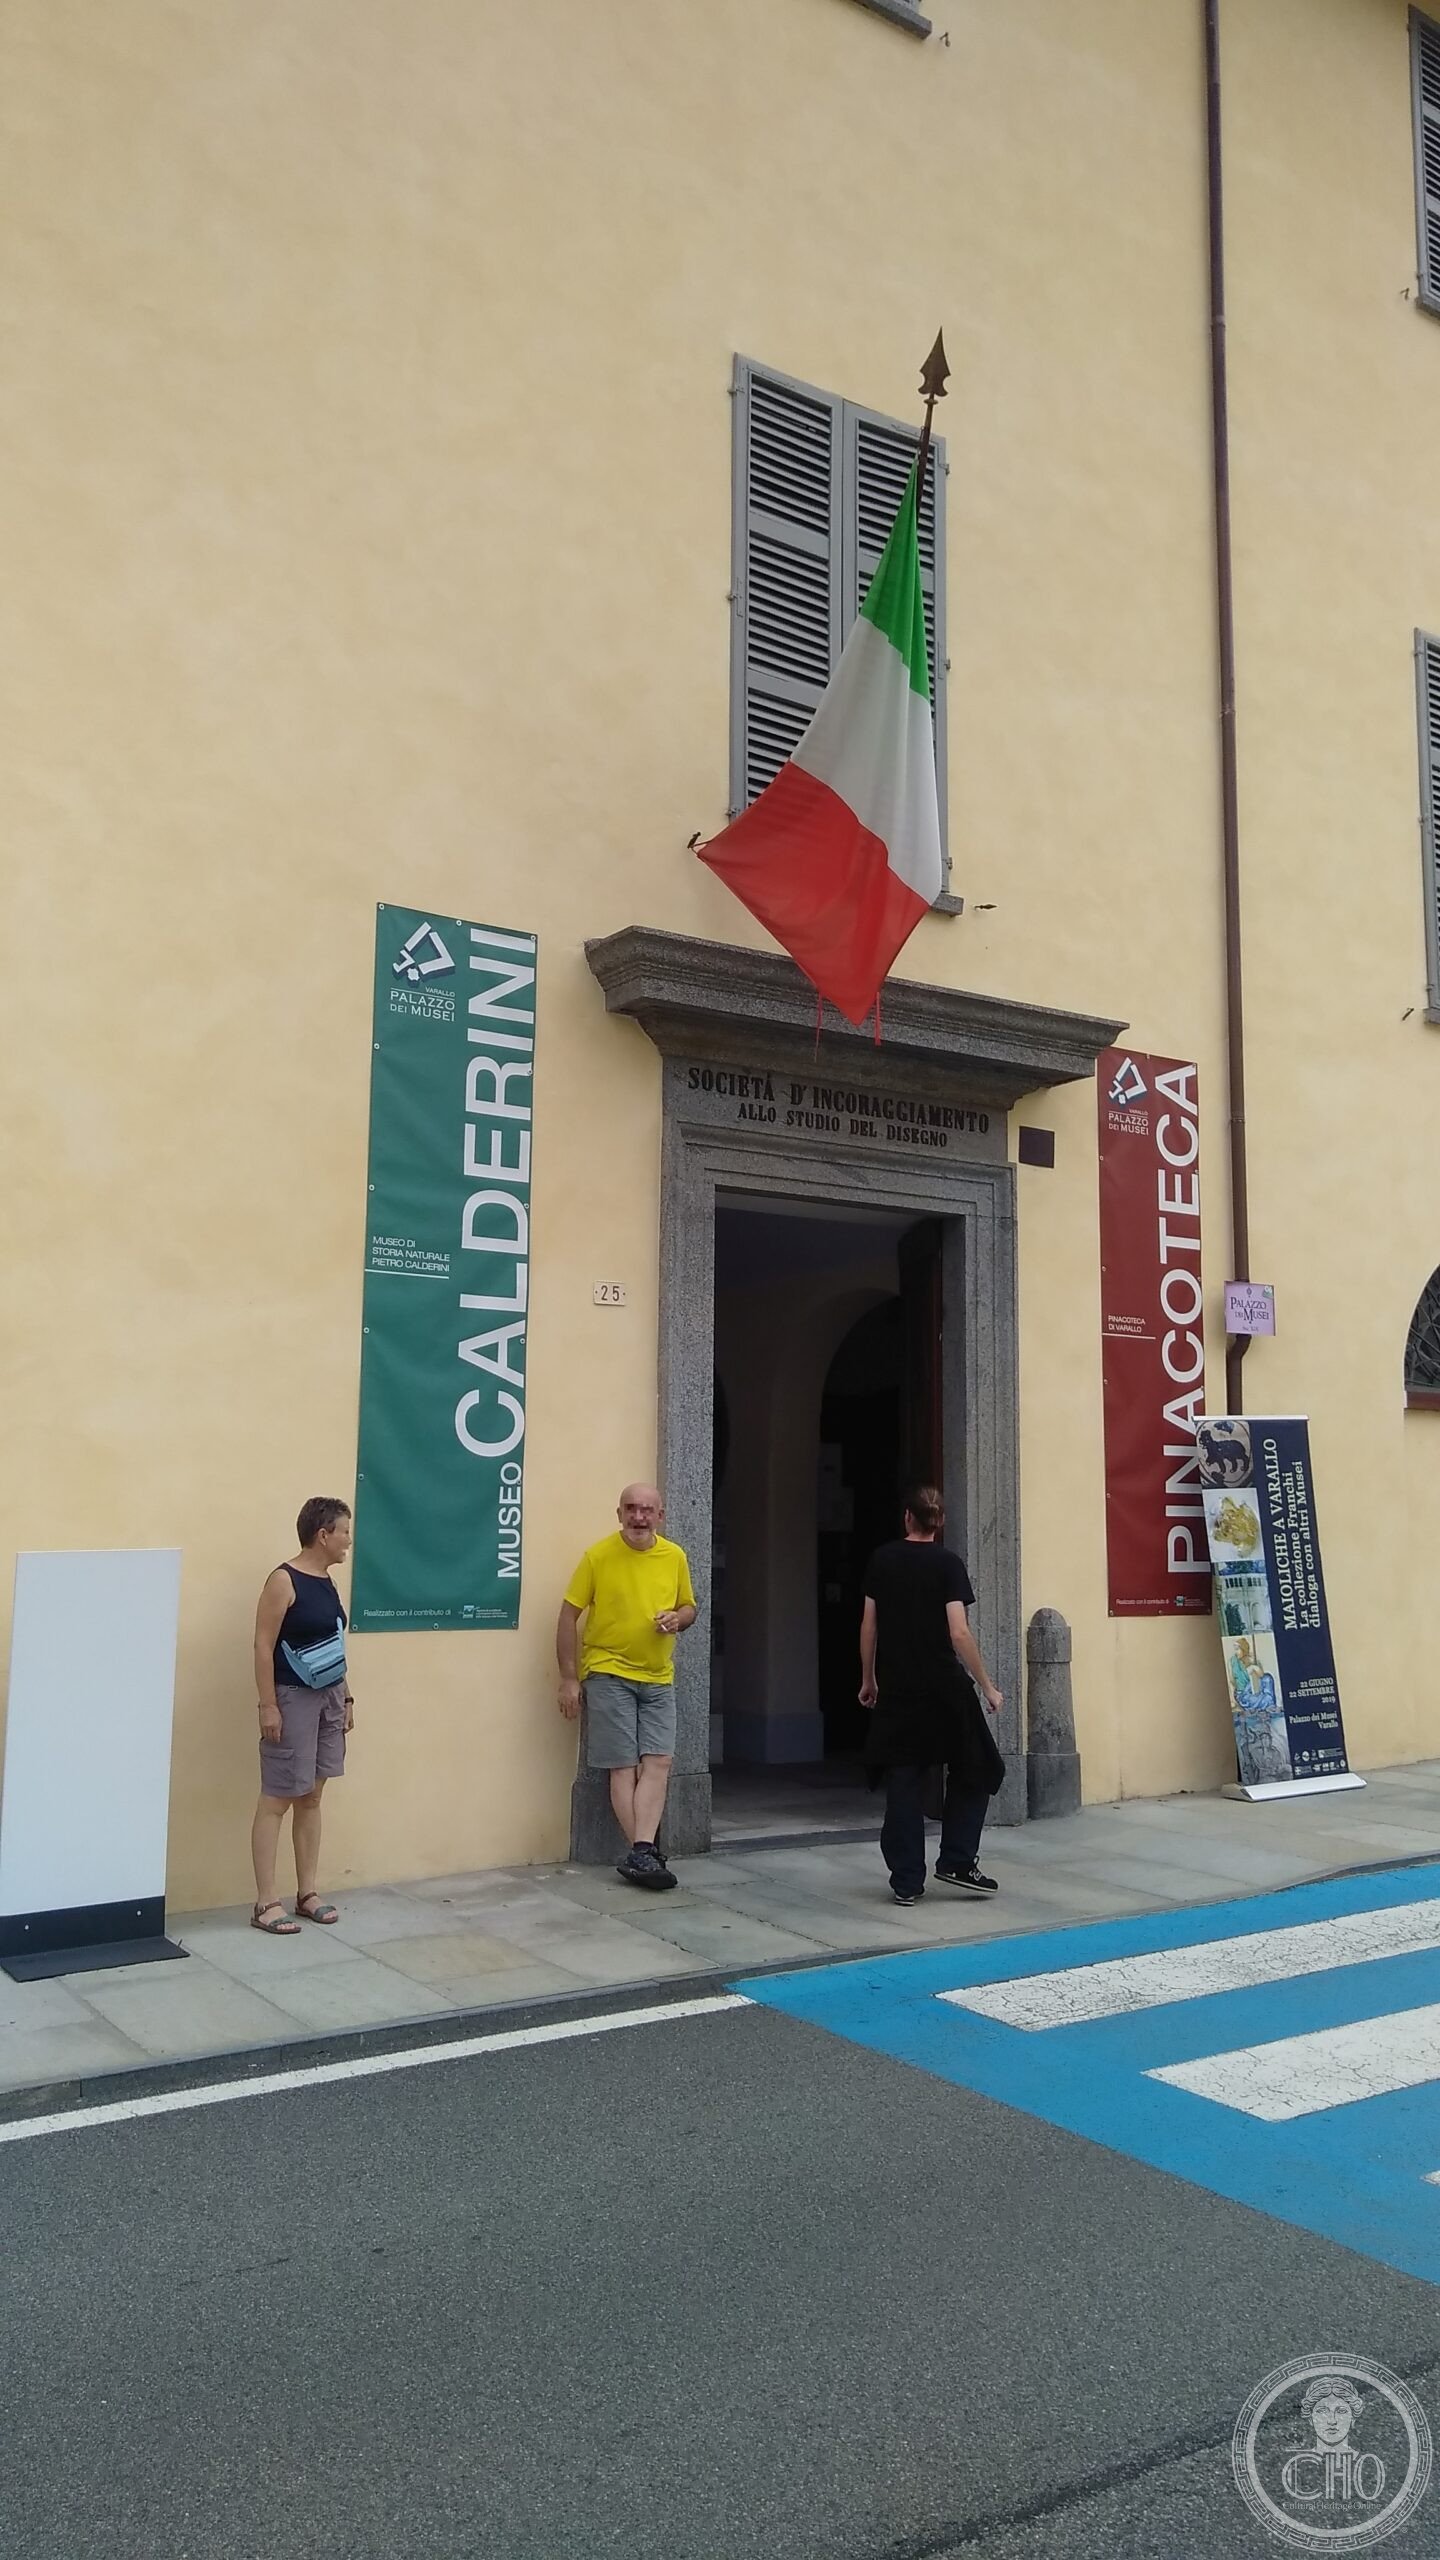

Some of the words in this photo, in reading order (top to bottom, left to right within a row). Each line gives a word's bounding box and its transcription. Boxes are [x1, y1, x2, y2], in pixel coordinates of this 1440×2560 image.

[390, 990, 455, 1010] PALAZZO
[425, 986, 456, 997] VARALLO
[390, 1003, 407, 1013] DEI
[411, 1005, 455, 1021] MUSEI
[737, 1102, 777, 1122] ALLO
[786, 1110, 840, 1132] STUDIO
[850, 1119, 877, 1138] DEL
[886, 1124, 948, 1148] DISEGNO
[1108, 1112, 1149, 1127] PALAZZO
[1120, 1124, 1149, 1136] MUSEI
[454, 928, 535, 1457] CALDERINI
[372, 1236, 405, 1247] MUSEO
[407, 1239, 416, 1248] DI
[372, 1246, 404, 1257] STORIA
[405, 1250, 450, 1262] NATURALE
[372, 1257, 404, 1268] PIETRO
[405, 1260, 450, 1272] CALDERINI
[600, 1284, 620, 1302] 25
[1108, 1315, 1146, 1325] PINACOTECA
[1155, 1063, 1211, 1573] PINACOTECA
[1115, 1324, 1142, 1333] VARALLO
[1263, 1439, 1283, 1516] VARALLO
[1291, 1461, 1307, 1505] Musei
[1282, 1472, 1298, 1528] Franchi
[497, 1462, 522, 1578] MUSEO
[1272, 1517, 1286, 1530] A
[1297, 1509, 1311, 1540] altri
[1304, 1544, 1314, 1570] con
[1291, 1532, 1307, 1606] collezione
[1273, 1533, 1298, 1630] MAIOLICHE
[1307, 1574, 1321, 1628] dialoga
[1300, 1610, 1310, 1628] La
